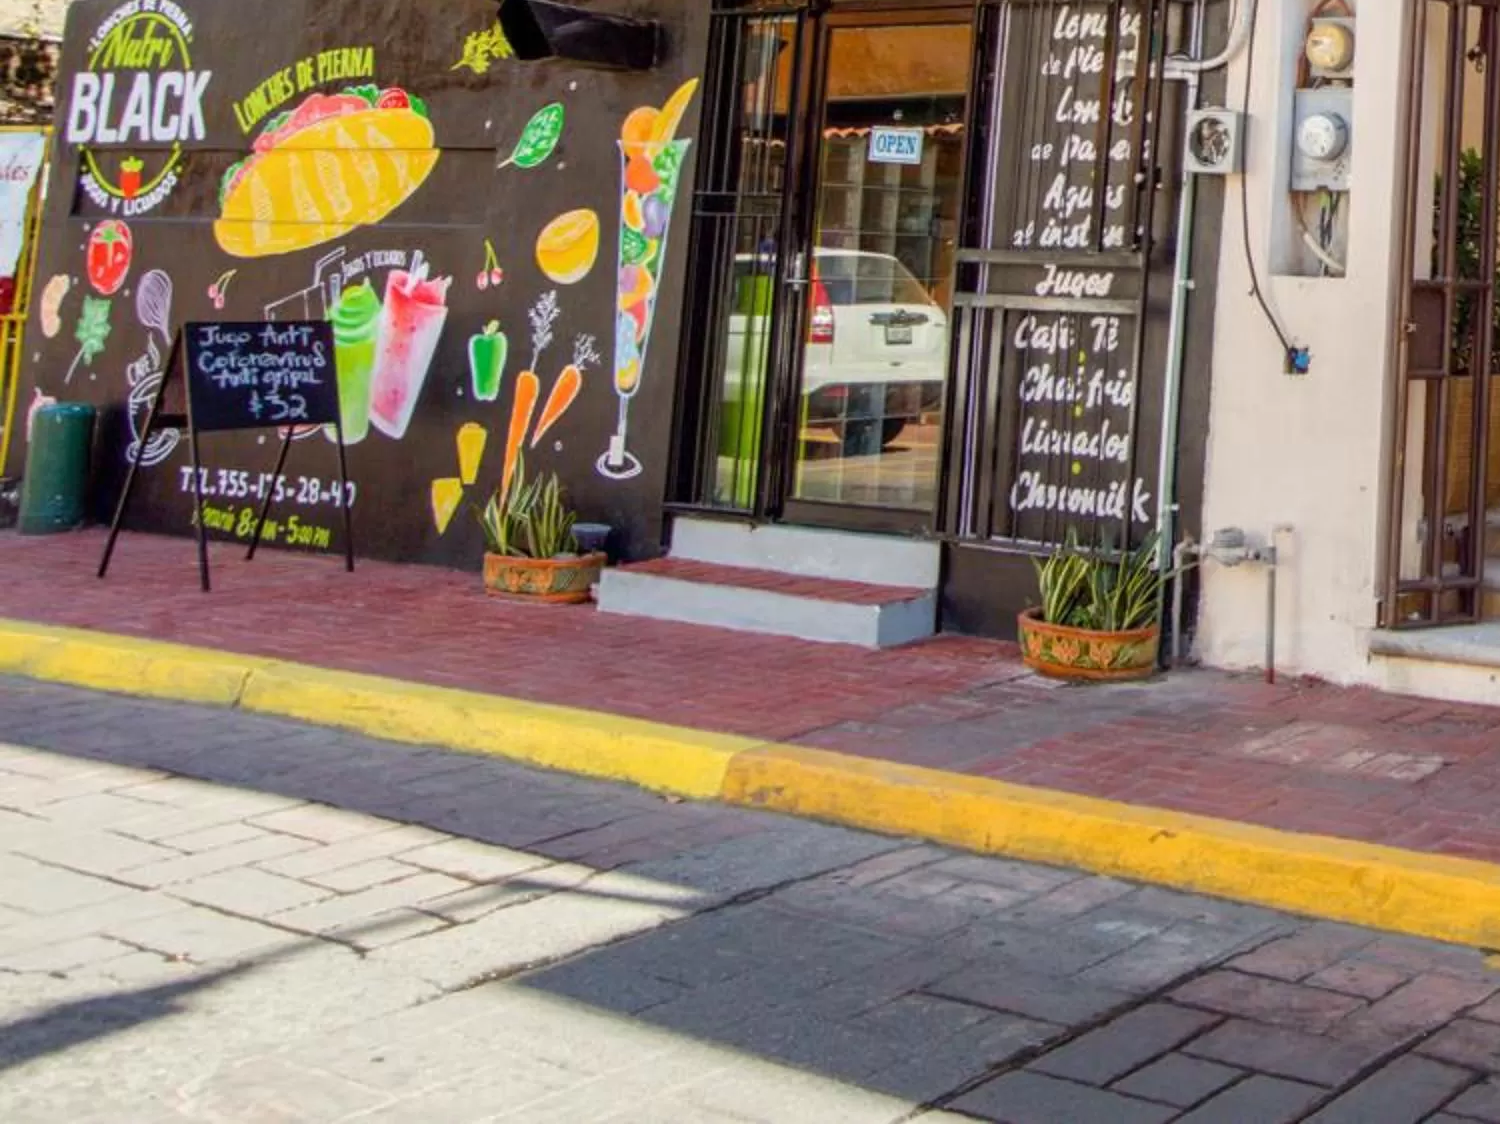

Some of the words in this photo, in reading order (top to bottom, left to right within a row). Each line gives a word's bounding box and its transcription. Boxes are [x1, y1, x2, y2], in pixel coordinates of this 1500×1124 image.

[67, 69, 213, 143] BLACK
[232, 66, 294, 134] LONCHES
[295, 57, 316, 93] DE
[317, 46, 374, 84] PIERNA
[875, 135, 917, 154] OPEN
[1042, 172, 1126, 219] Agus
[1034, 263, 1115, 298] Jugos
[198, 325, 253, 349] Jugo
[248, 389, 309, 420] $32
